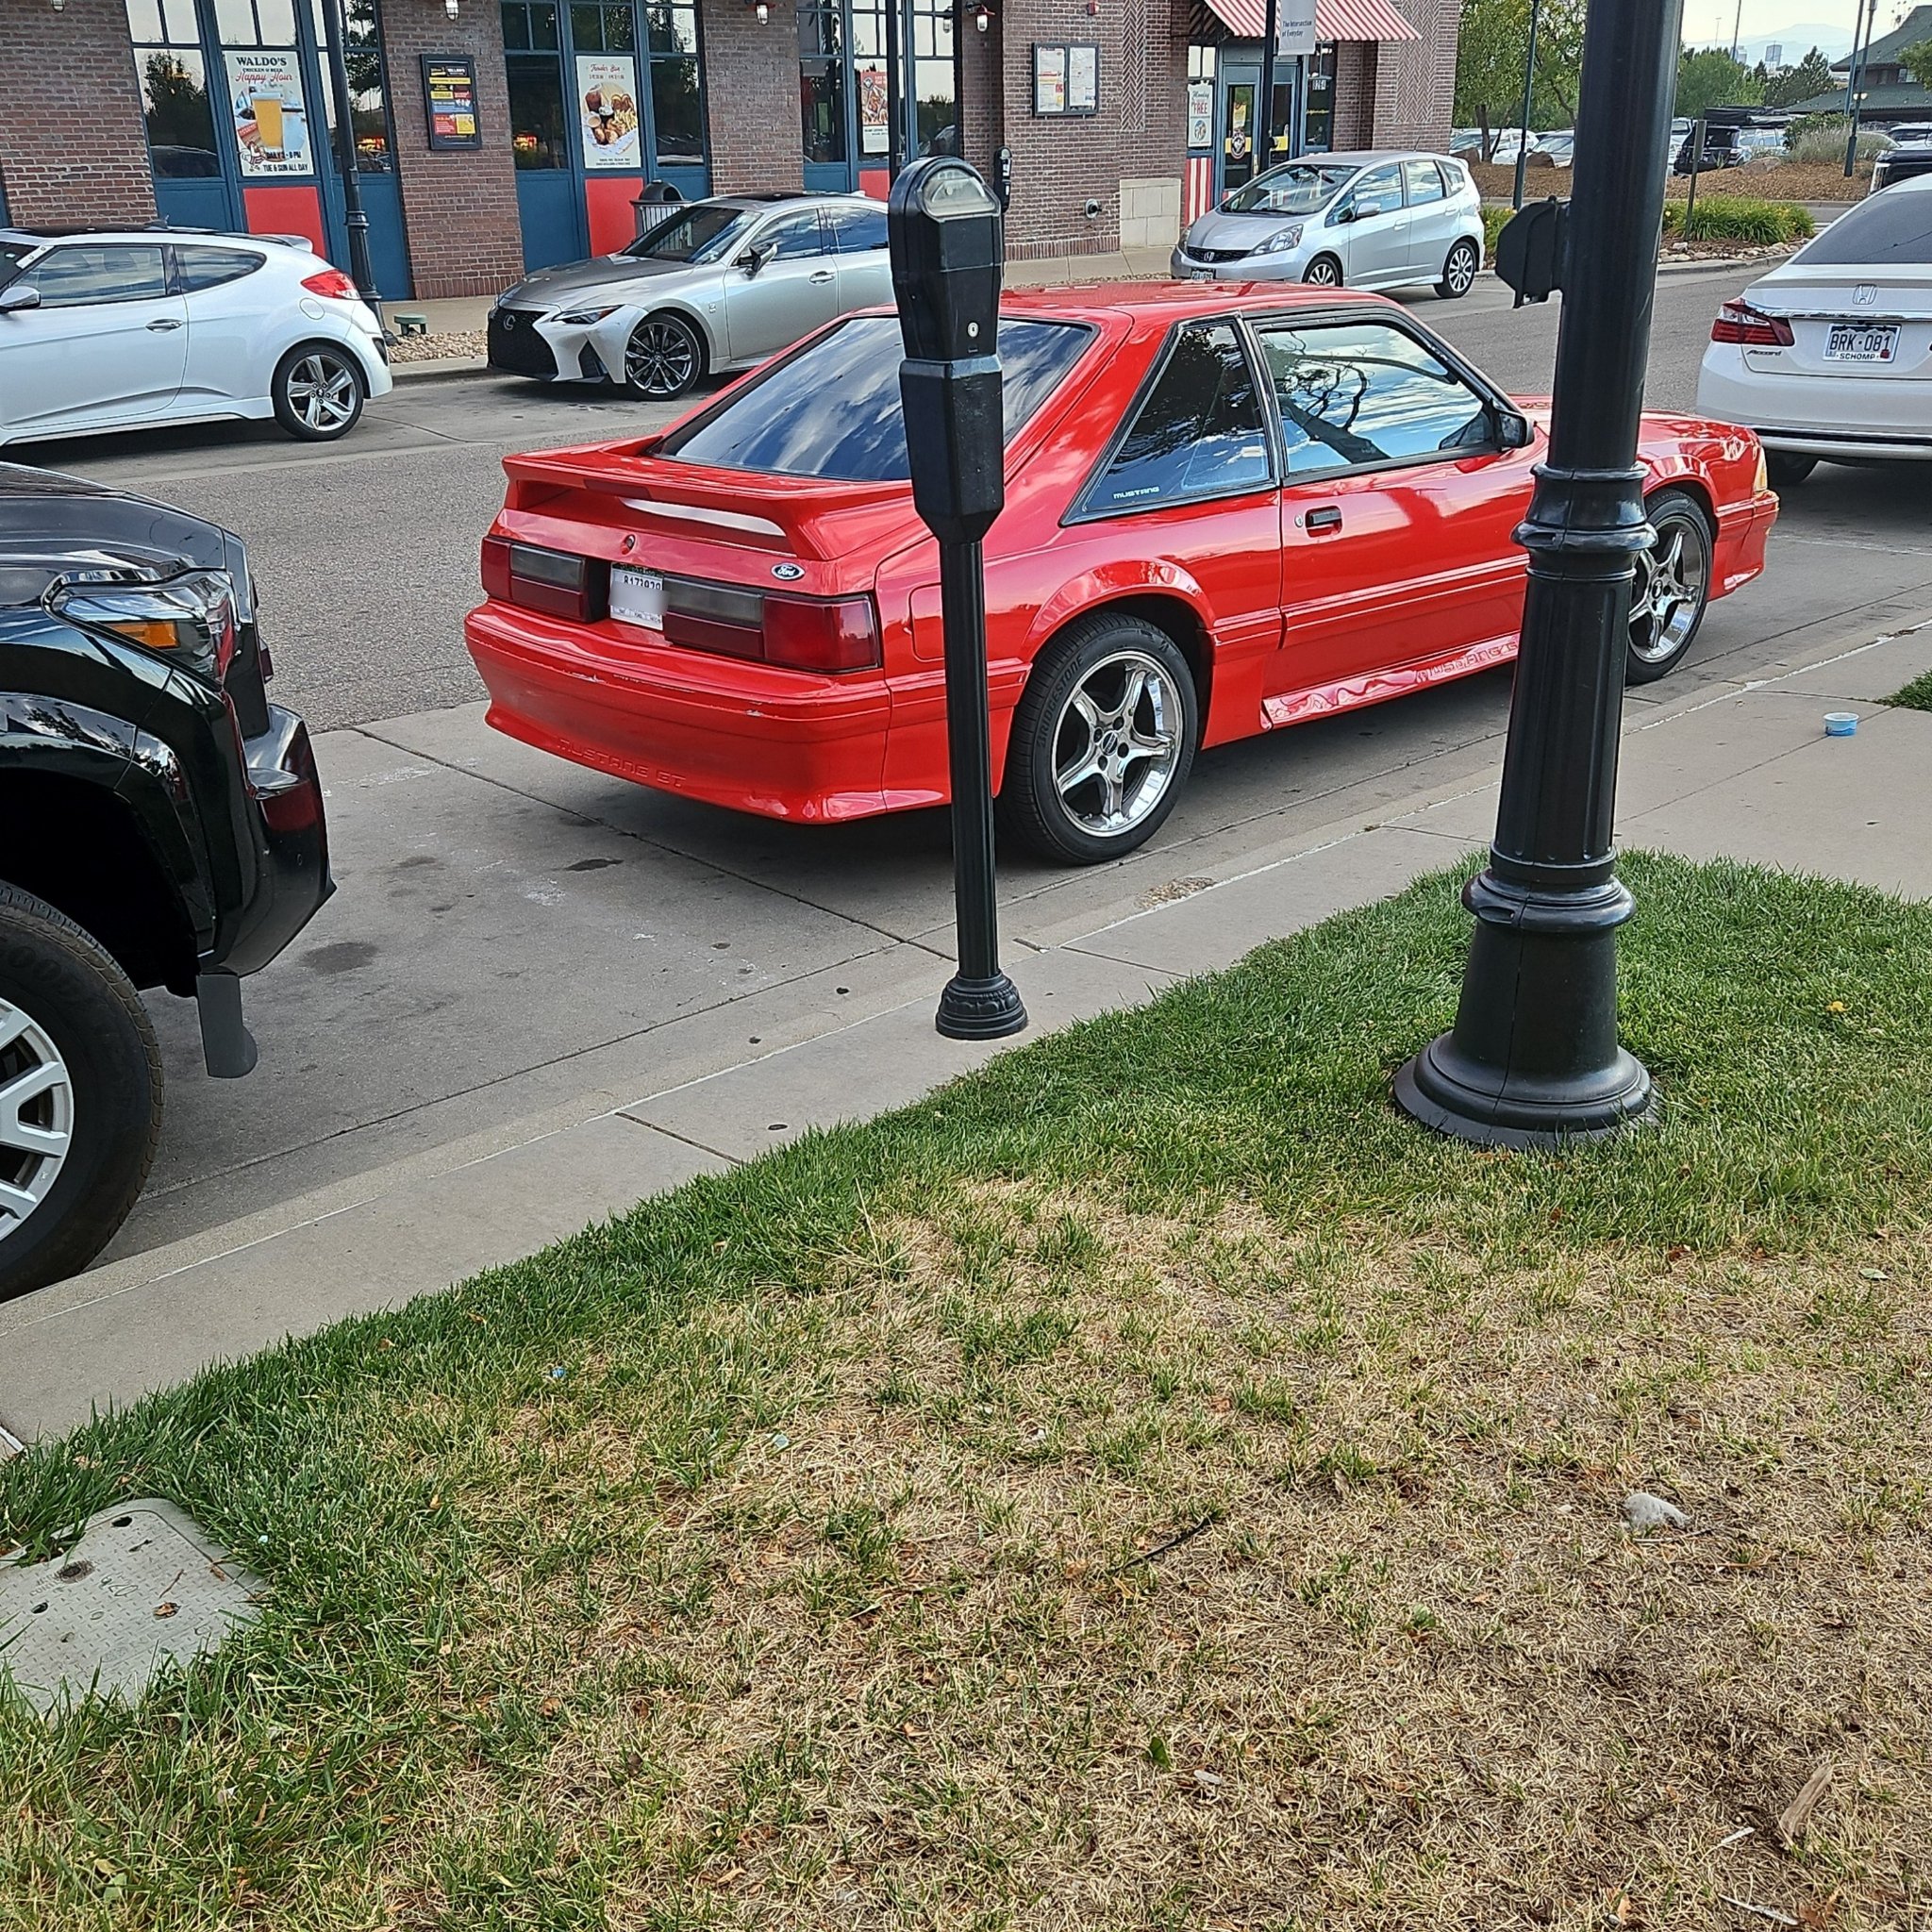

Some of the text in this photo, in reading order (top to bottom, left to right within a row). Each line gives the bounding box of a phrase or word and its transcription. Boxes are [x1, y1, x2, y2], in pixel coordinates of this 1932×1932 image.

[236, 57, 288, 66] WALDO'S
[235, 72, 292, 84] Happy Hour
[289, 163, 298, 172] ALL
[298, 163, 308, 172] DAY
[777, 565, 795, 575] Ford
[557, 739, 687, 788] MUSTANG GT
